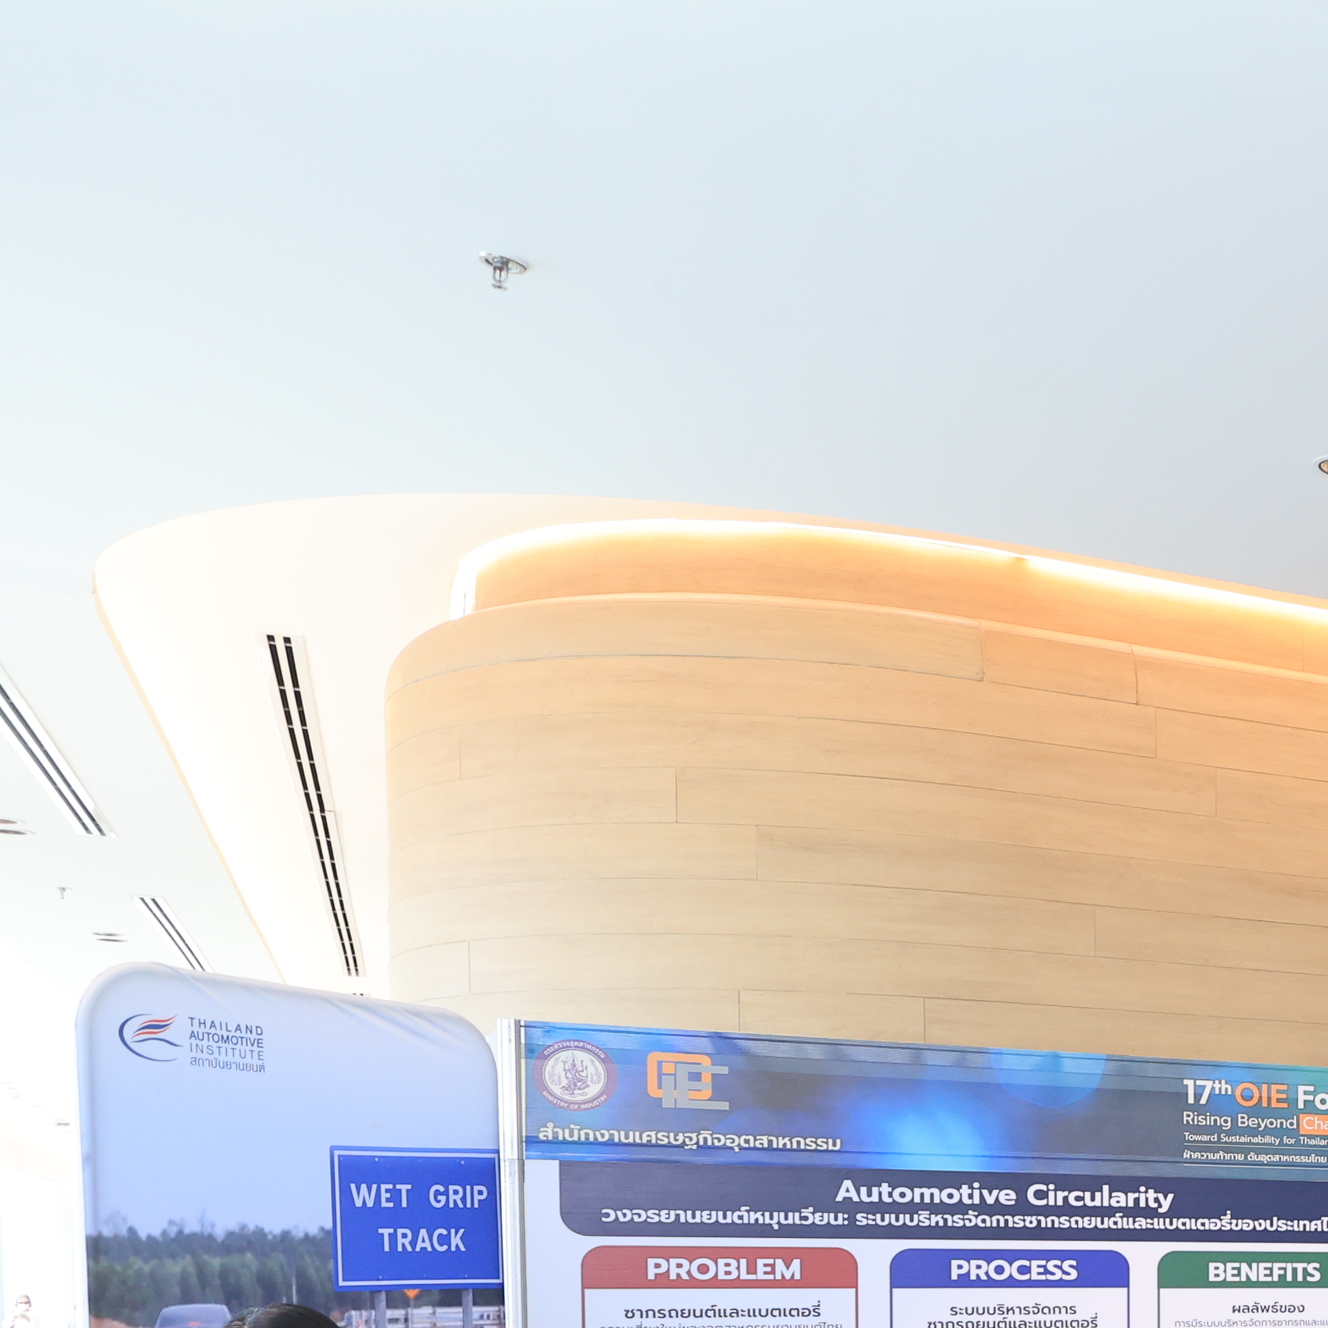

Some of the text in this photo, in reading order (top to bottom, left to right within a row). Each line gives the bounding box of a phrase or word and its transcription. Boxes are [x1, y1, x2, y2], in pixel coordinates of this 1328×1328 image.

[188, 1016, 264, 1036] THAILAND
[189, 1030, 264, 1049] AUTOMOTIVE
[189, 1042, 265, 1061] INSTITUTE
[190, 1056, 266, 1073] สถาบันยานยนต์
[1182, 1079, 1232, 1105] 17th
[1235, 1082, 1289, 1108] OIE
[1183, 1111, 1232, 1128] Rising
[1238, 1113, 1297, 1132] Beyond
[538, 1121, 842, 1152] สำนักงานเศรษฐกิจอุตสาหกรรม
[1184, 1132, 1218, 1143] Toward
[1220, 1133, 1281, 1146] Sustainability
[1283, 1135, 1296, 1145] for
[350, 1183, 488, 1209] WET GRIP
[835, 1179, 1175, 1213] Automotive Circularity
[601, 1206, 849, 1231] วงจรยานยนต์หมุนเวียน:
[378, 1228, 466, 1252] TRACK
[646, 1257, 802, 1281] PROBLEM
[950, 1258, 1079, 1281] PROCESS
[1208, 1261, 1321, 1283] BENEFITS
[624, 1300, 822, 1319] ซากรถยนต์และแบตเตอรี่
[950, 1302, 1077, 1316] ระบบบริหารจัดการ
[1232, 1301, 1305, 1314] ผลลัพธ์ของ
